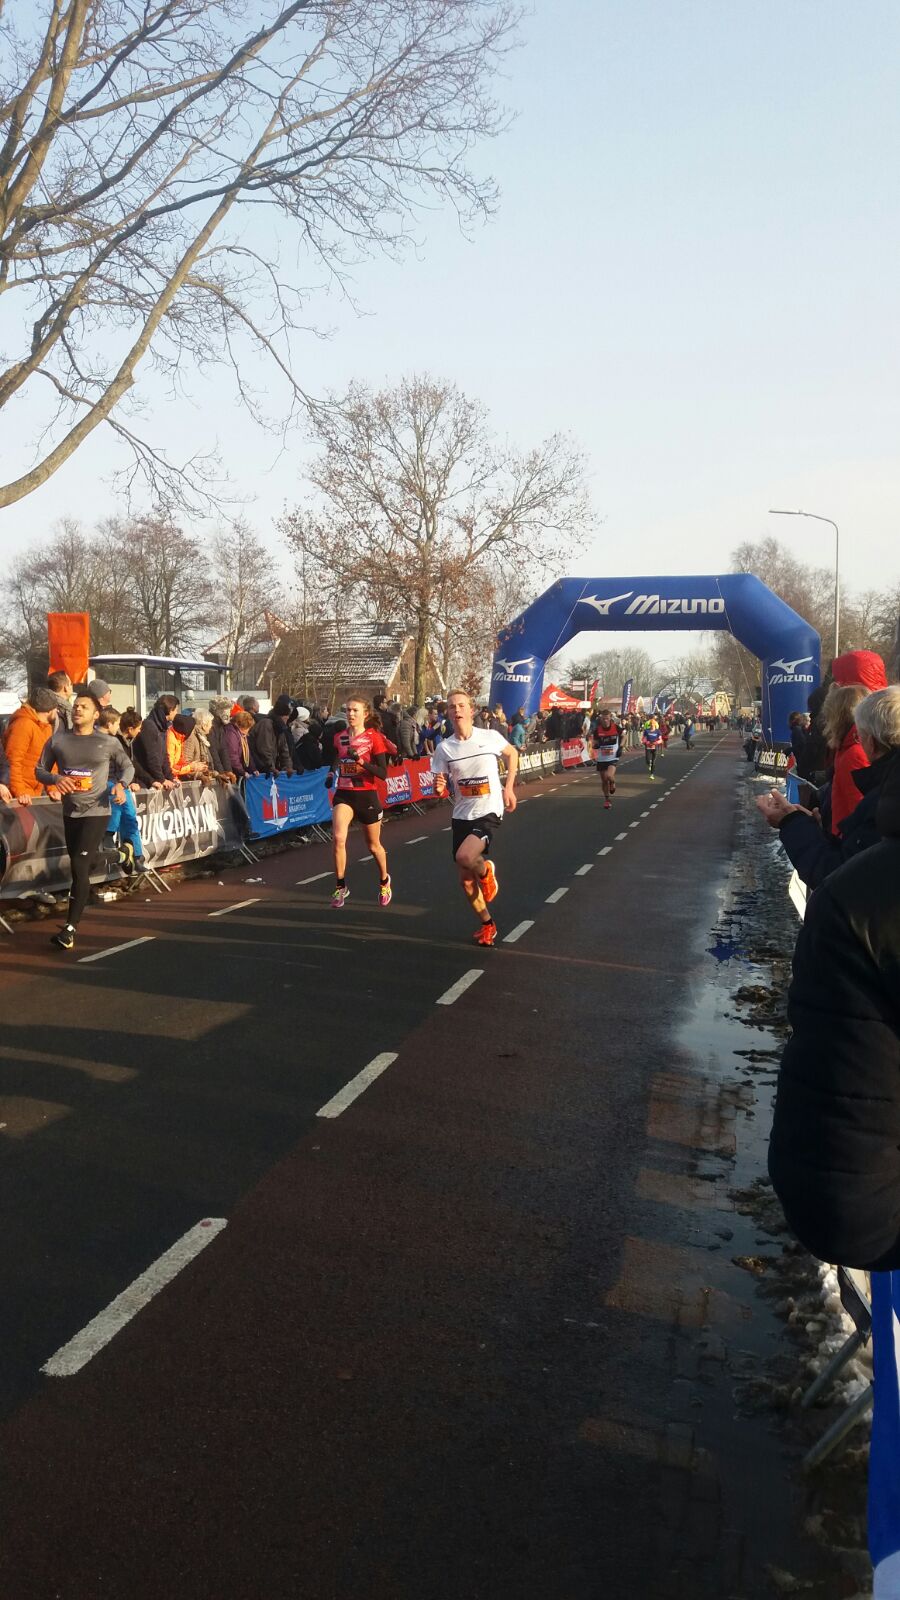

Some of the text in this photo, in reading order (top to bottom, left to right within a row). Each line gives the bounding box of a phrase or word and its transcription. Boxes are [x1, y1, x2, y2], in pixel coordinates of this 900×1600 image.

[624, 594, 725, 615] MIZUNO
[493, 672, 531, 683] MIZUNO
[769, 674, 814, 685] MIZUNO
